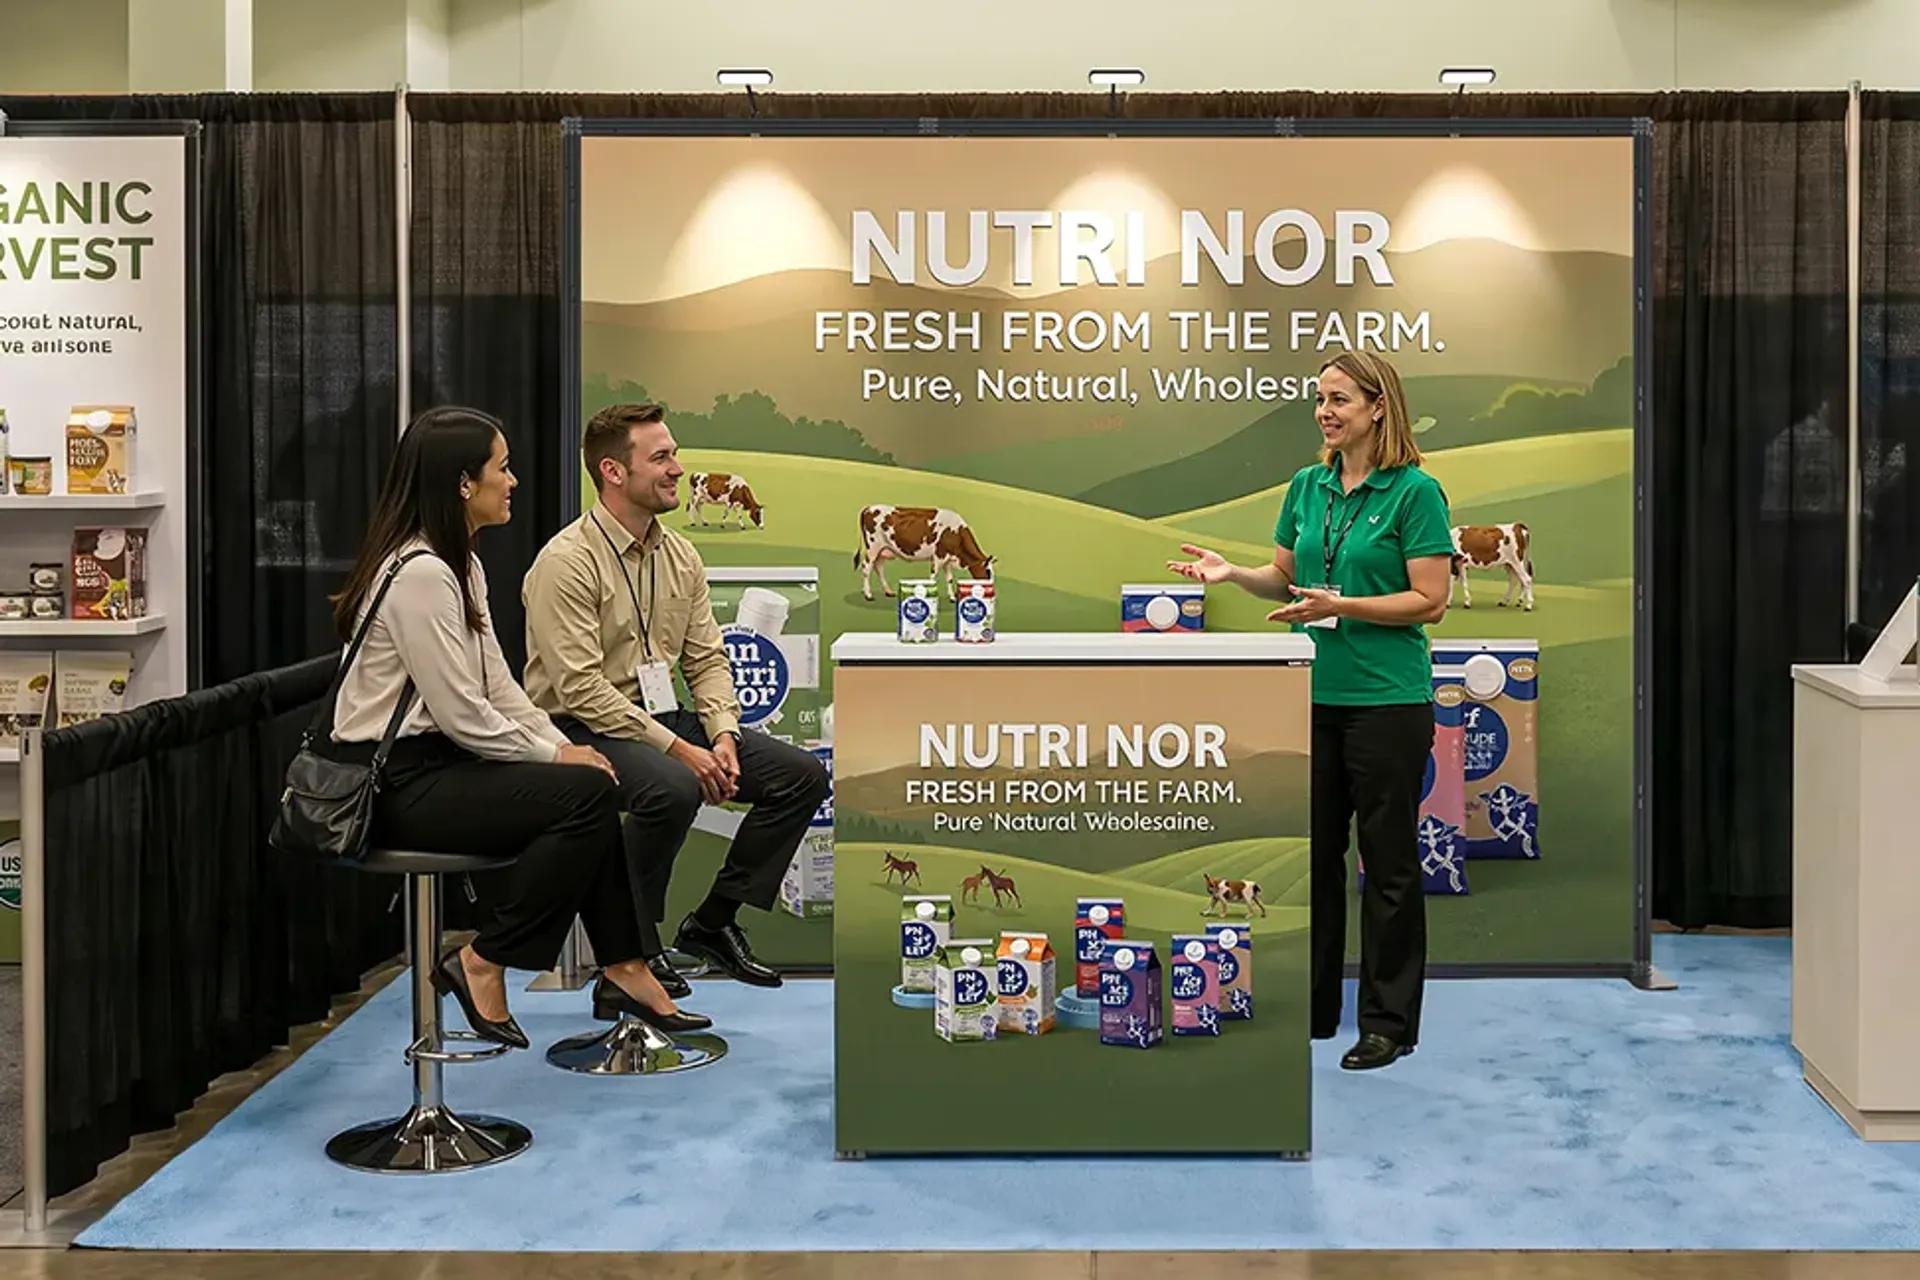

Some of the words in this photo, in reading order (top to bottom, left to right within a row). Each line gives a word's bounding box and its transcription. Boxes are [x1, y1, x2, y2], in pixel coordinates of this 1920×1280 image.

[0, 181, 153, 224] ANIC
[850, 209, 1146, 287] NUTRI
[1180, 209, 1395, 287] NOR
[813, 311, 983, 352] FRESH
[1002, 311, 1152, 352] FROM
[1169, 311, 1277, 352] THE
[1289, 311, 1447, 352] FARM.
[862, 367, 962, 405] Pure,
[976, 367, 1138, 405] Natural,
[734, 687, 777, 707] or
[919, 723, 1089, 769] NUTRI
[1106, 723, 1228, 769] NOR
[905, 780, 995, 804] FRESH
[1005, 780, 1087, 804] FROM
[1096, 780, 1149, 804] THE
[1158, 780, 1243, 804] FARM.
[933, 811, 984, 832] Pure
